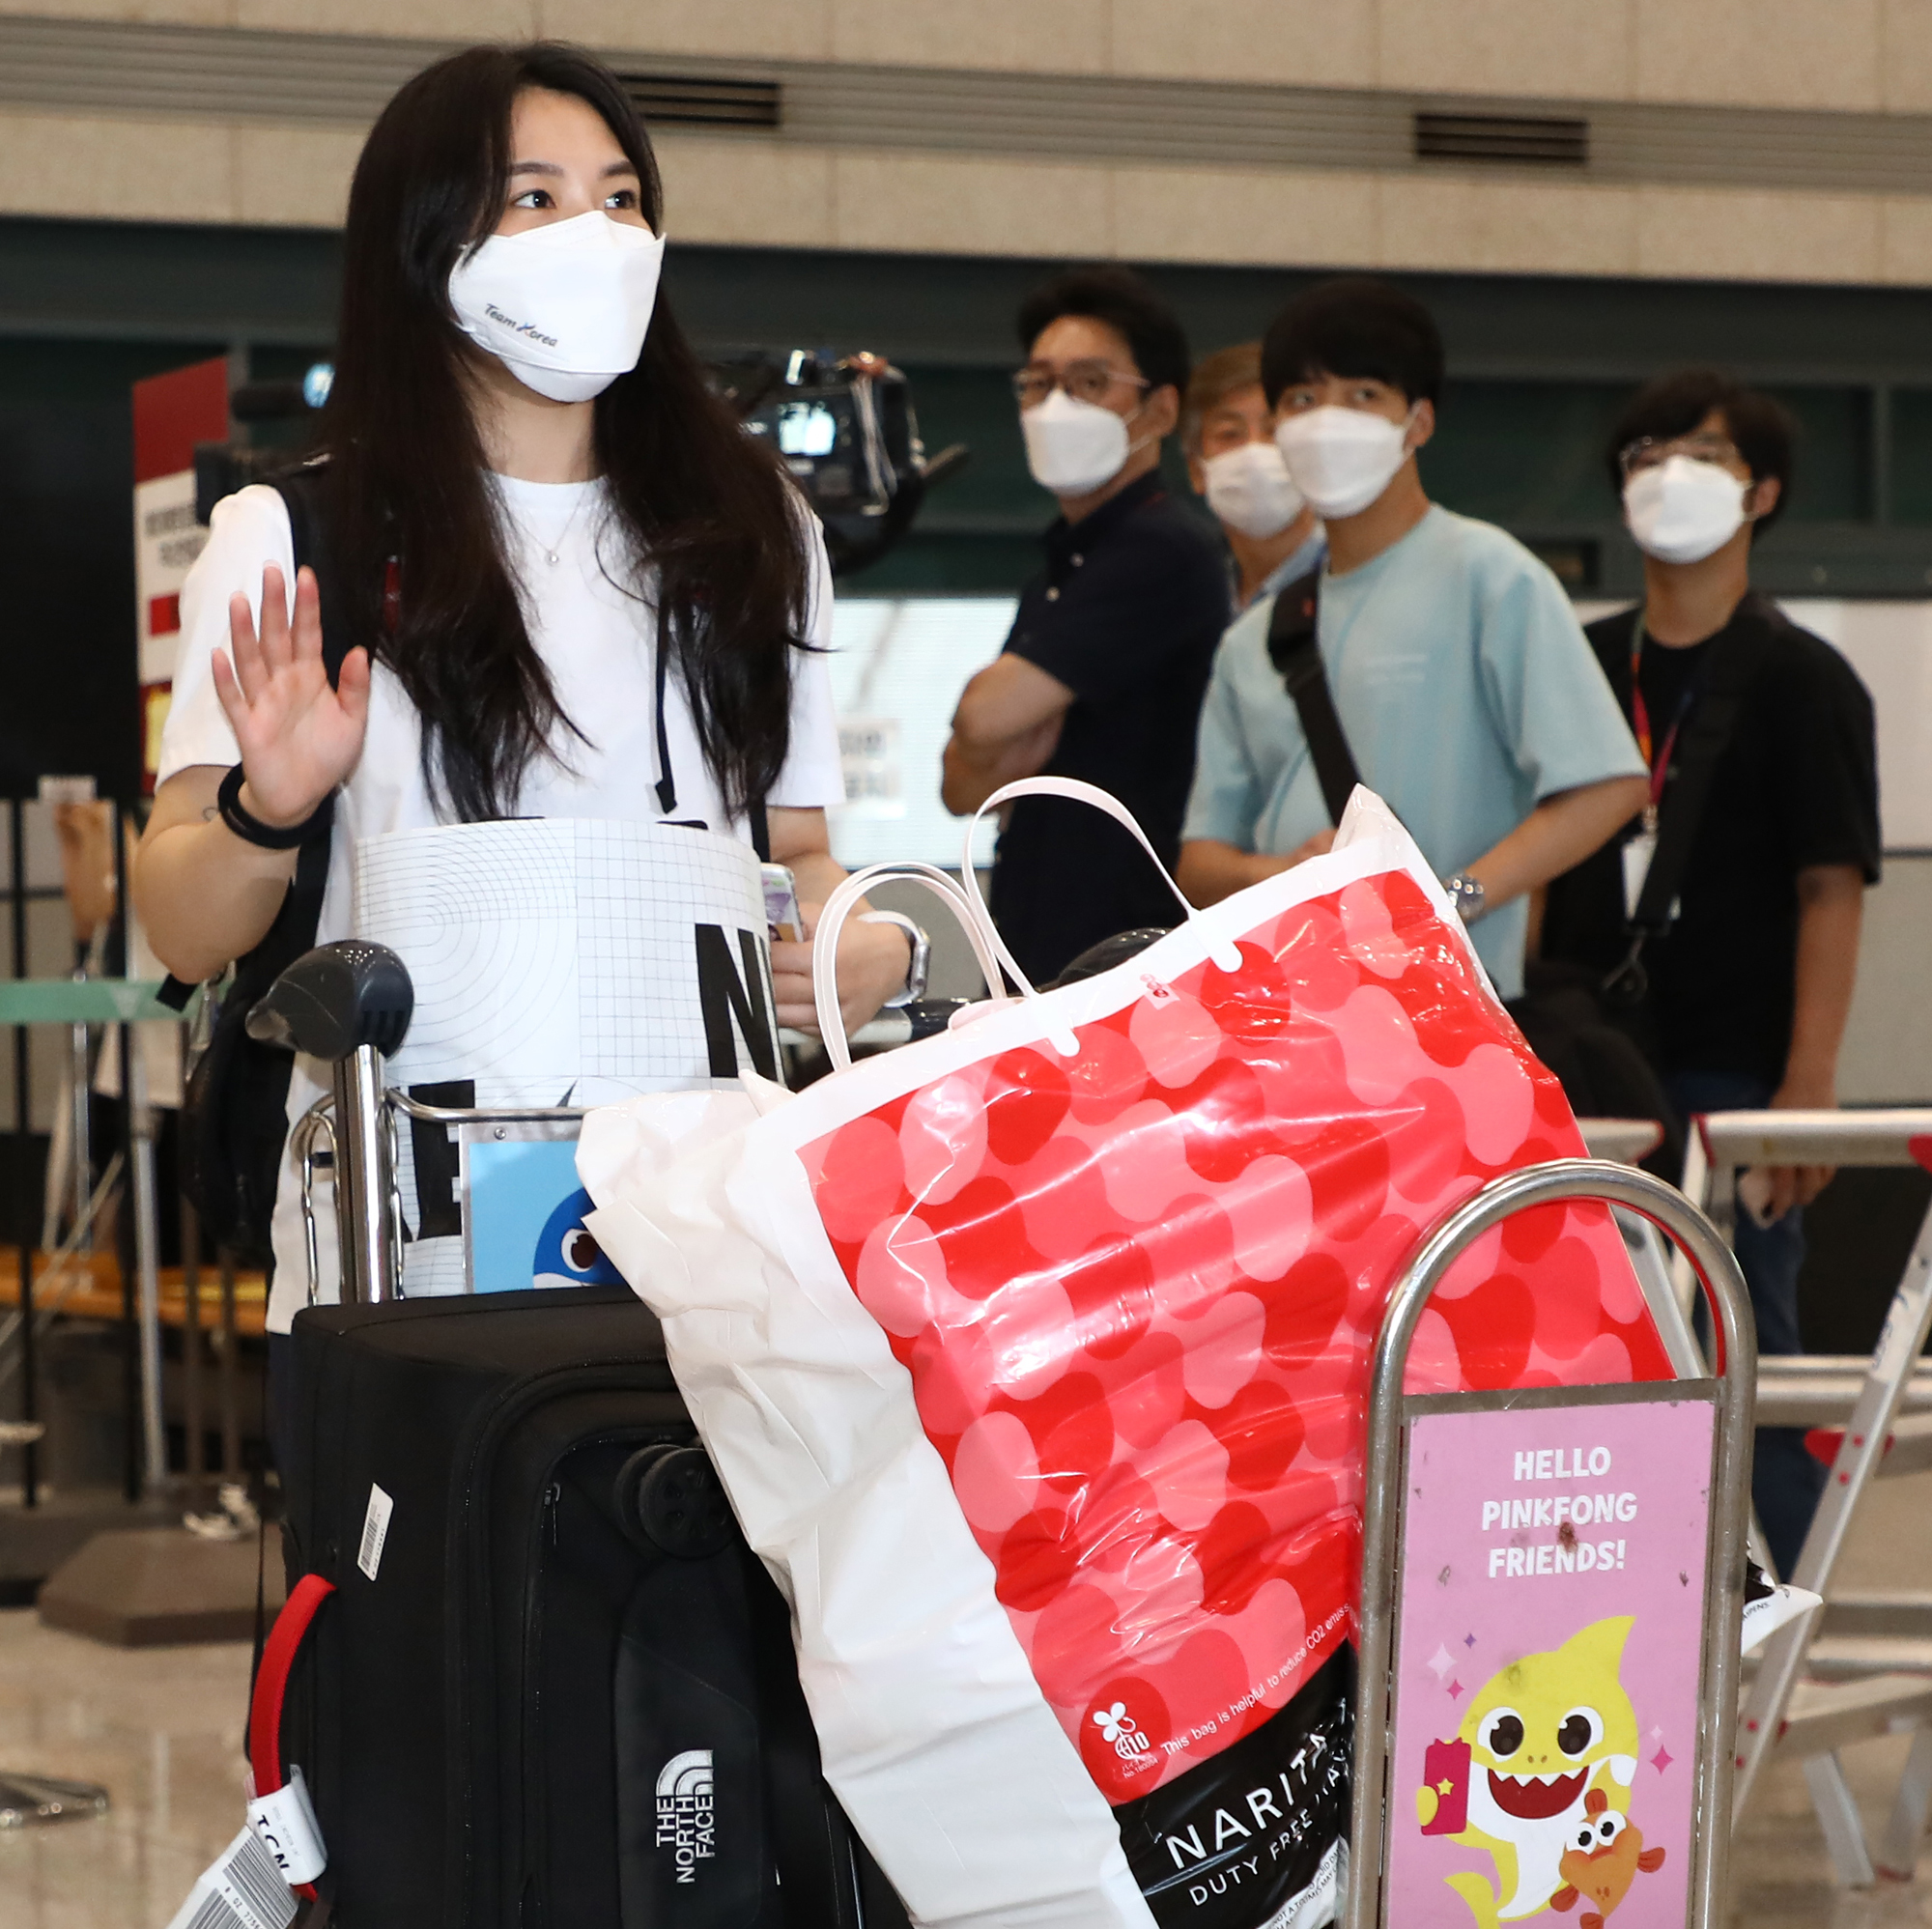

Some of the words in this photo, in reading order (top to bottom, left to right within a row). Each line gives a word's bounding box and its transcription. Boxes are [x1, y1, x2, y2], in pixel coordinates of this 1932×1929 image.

[485, 302, 517, 328] Team
[516, 322, 557, 348] Korea
[1514, 1446, 1611, 1481] HELLO
[1482, 1492, 1637, 1530] PINKFONG
[1489, 1539, 1626, 1578] FRIENDS!
[1160, 1735, 1190, 1756] This
[1191, 1719, 1217, 1741] bag
[1218, 1711, 1231, 1724] is
[1230, 1684, 1266, 1716] helpful
[1266, 1674, 1280, 1688] to
[1280, 1645, 1308, 1679] reduce
[1306, 1625, 1326, 1650] CO2
[657, 1797, 676, 1847] THE
[696, 1796, 715, 1858] FACE
[1165, 1733, 1327, 1870] NARITA
[676, 1797, 696, 1884] NORTH
[1188, 1856, 1259, 1907] DUTY
[1269, 1808, 1313, 1861] FREE
